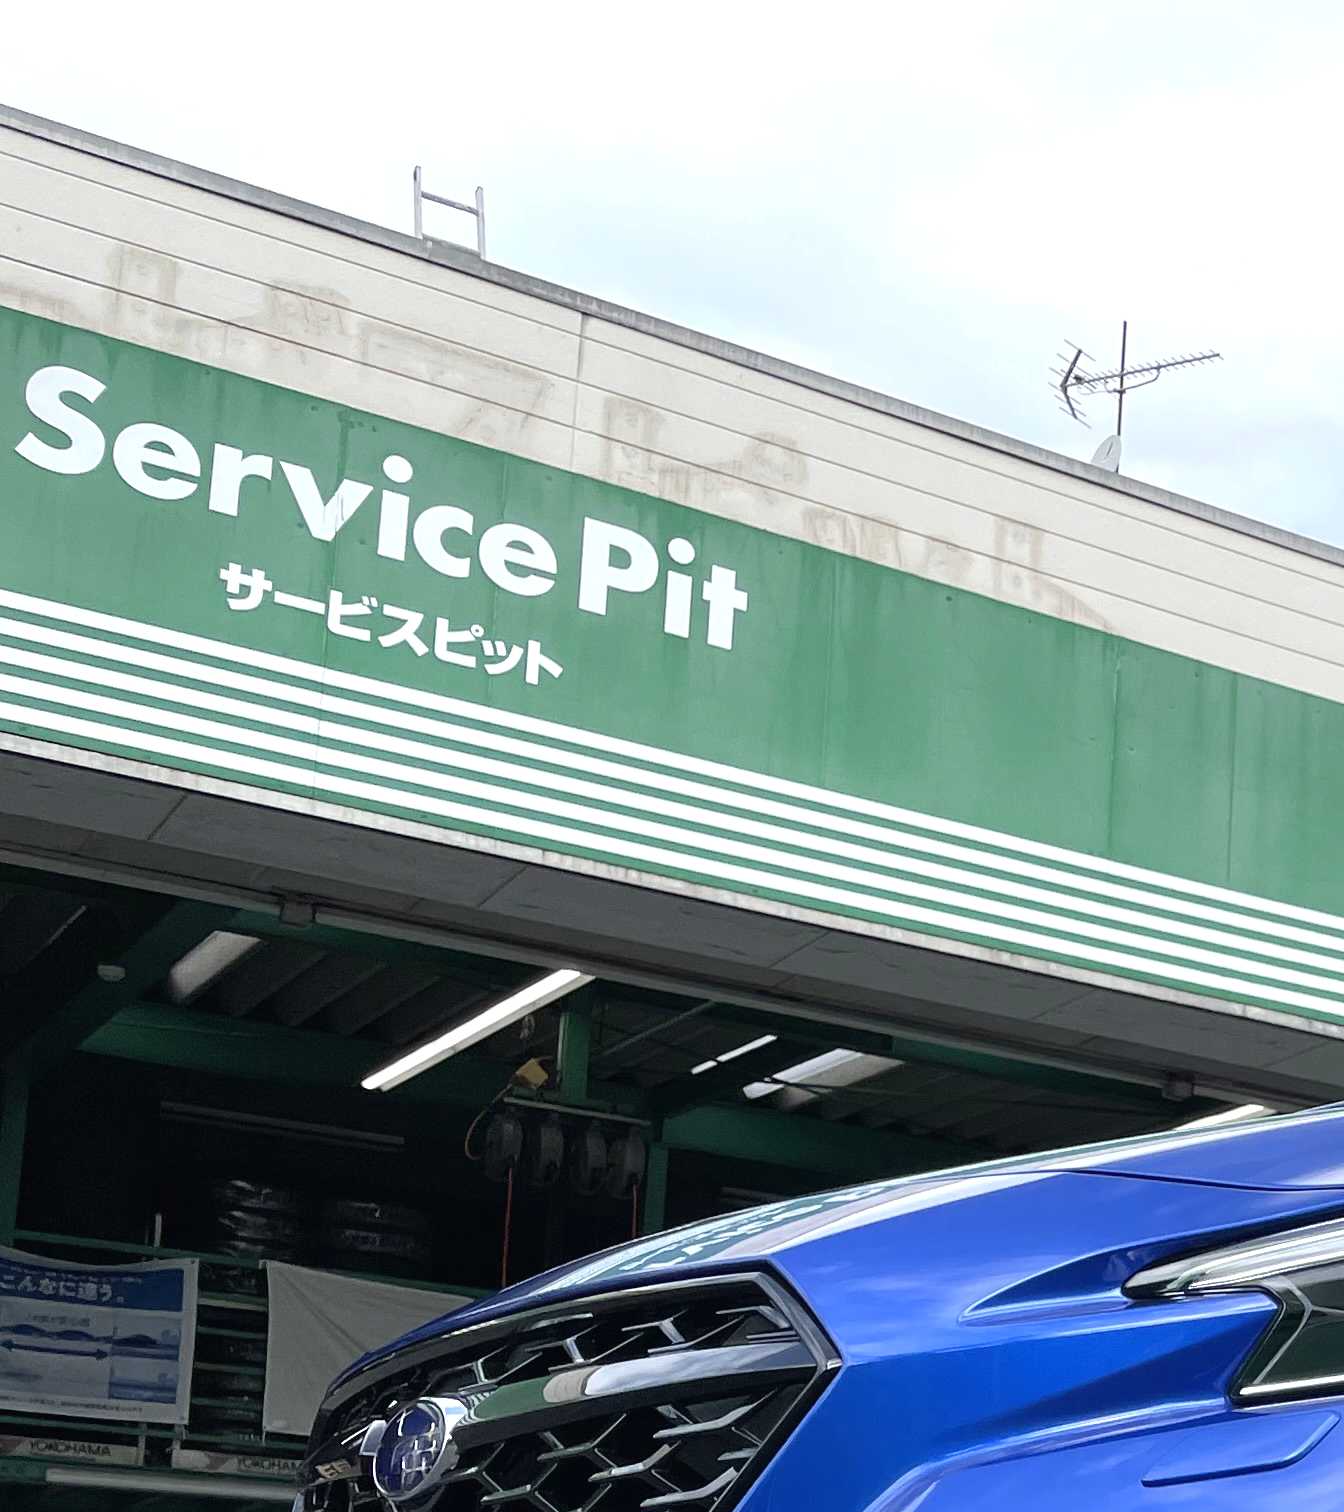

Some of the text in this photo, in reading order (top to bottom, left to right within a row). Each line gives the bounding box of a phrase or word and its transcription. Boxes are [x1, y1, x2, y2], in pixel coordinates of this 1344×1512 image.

[14, 366, 748, 650] Service Pit
[219, 561, 564, 686] サービスピット
[30, 1439, 113, 1457] YOKOHAMA
[237, 1455, 302, 1472] YOKOHAM
